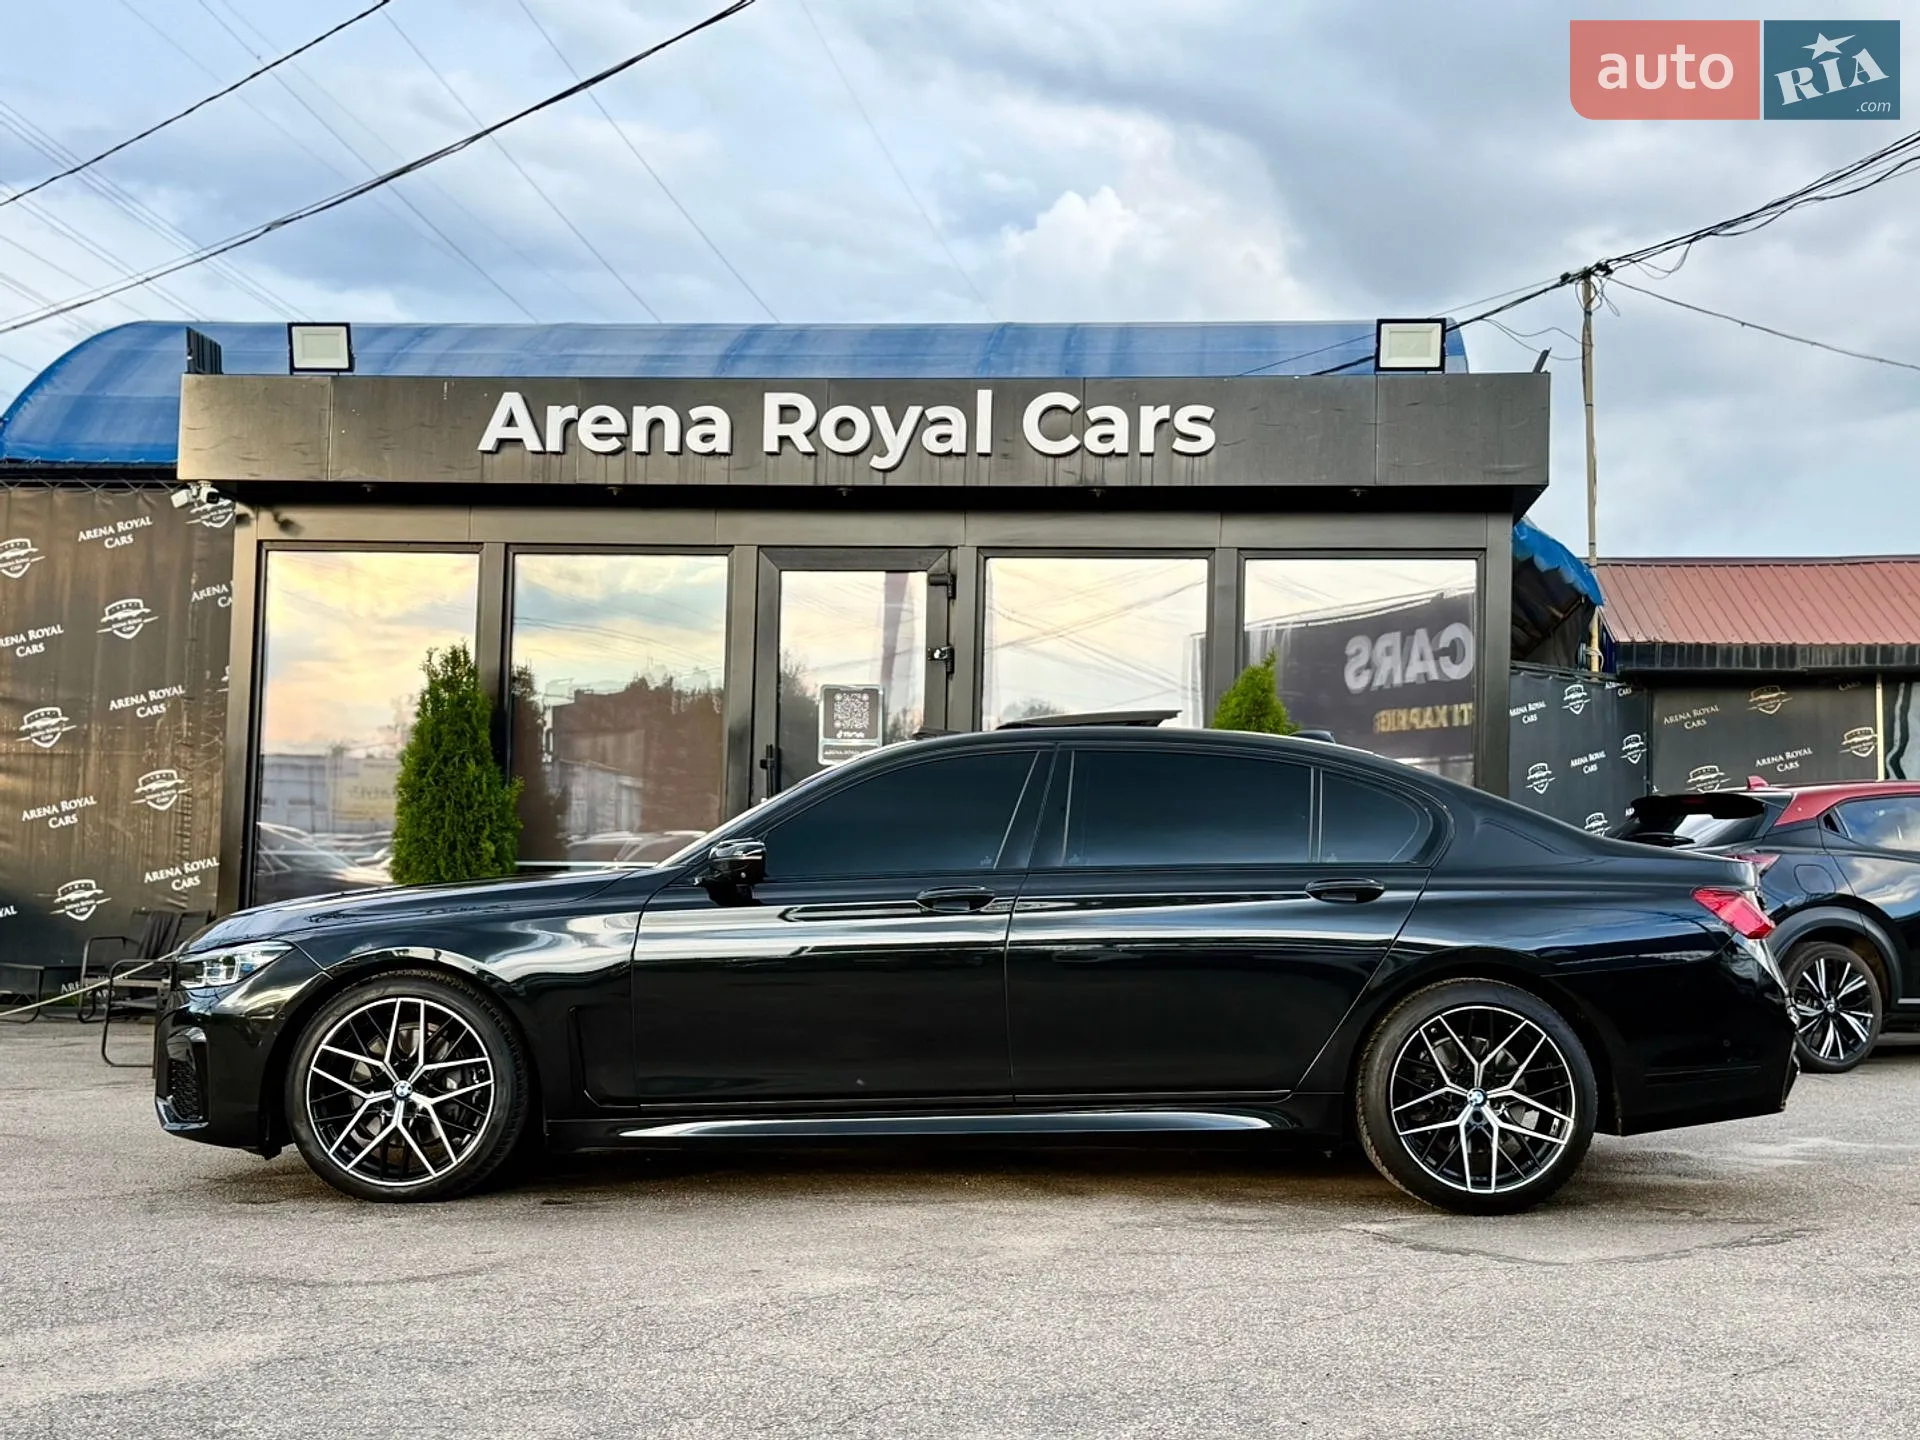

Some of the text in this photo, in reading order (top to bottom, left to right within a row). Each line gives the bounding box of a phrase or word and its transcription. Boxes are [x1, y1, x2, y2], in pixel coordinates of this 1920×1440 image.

[477, 389, 1217, 471] Arena Royal Cars
[78, 516, 153, 542] ARENA ROYAL
[104, 534, 134, 549] CARS
[28, 624, 64, 640] ROYAL
[16, 642, 45, 657] CARS
[109, 684, 185, 711] ARENA ROYAL
[135, 703, 167, 718] CARS
[1663, 704, 1720, 725] ARENA ROYAL
[1684, 718, 1708, 730] CARS
[1755, 747, 1813, 768] ARENA ROYAL
[1777, 761, 1800, 773] CARS
[22, 795, 97, 821] ARENA ROYAL
[48, 814, 78, 828] CARS
[144, 857, 220, 883] ARENA ROYAL
[171, 876, 201, 891] CARS
